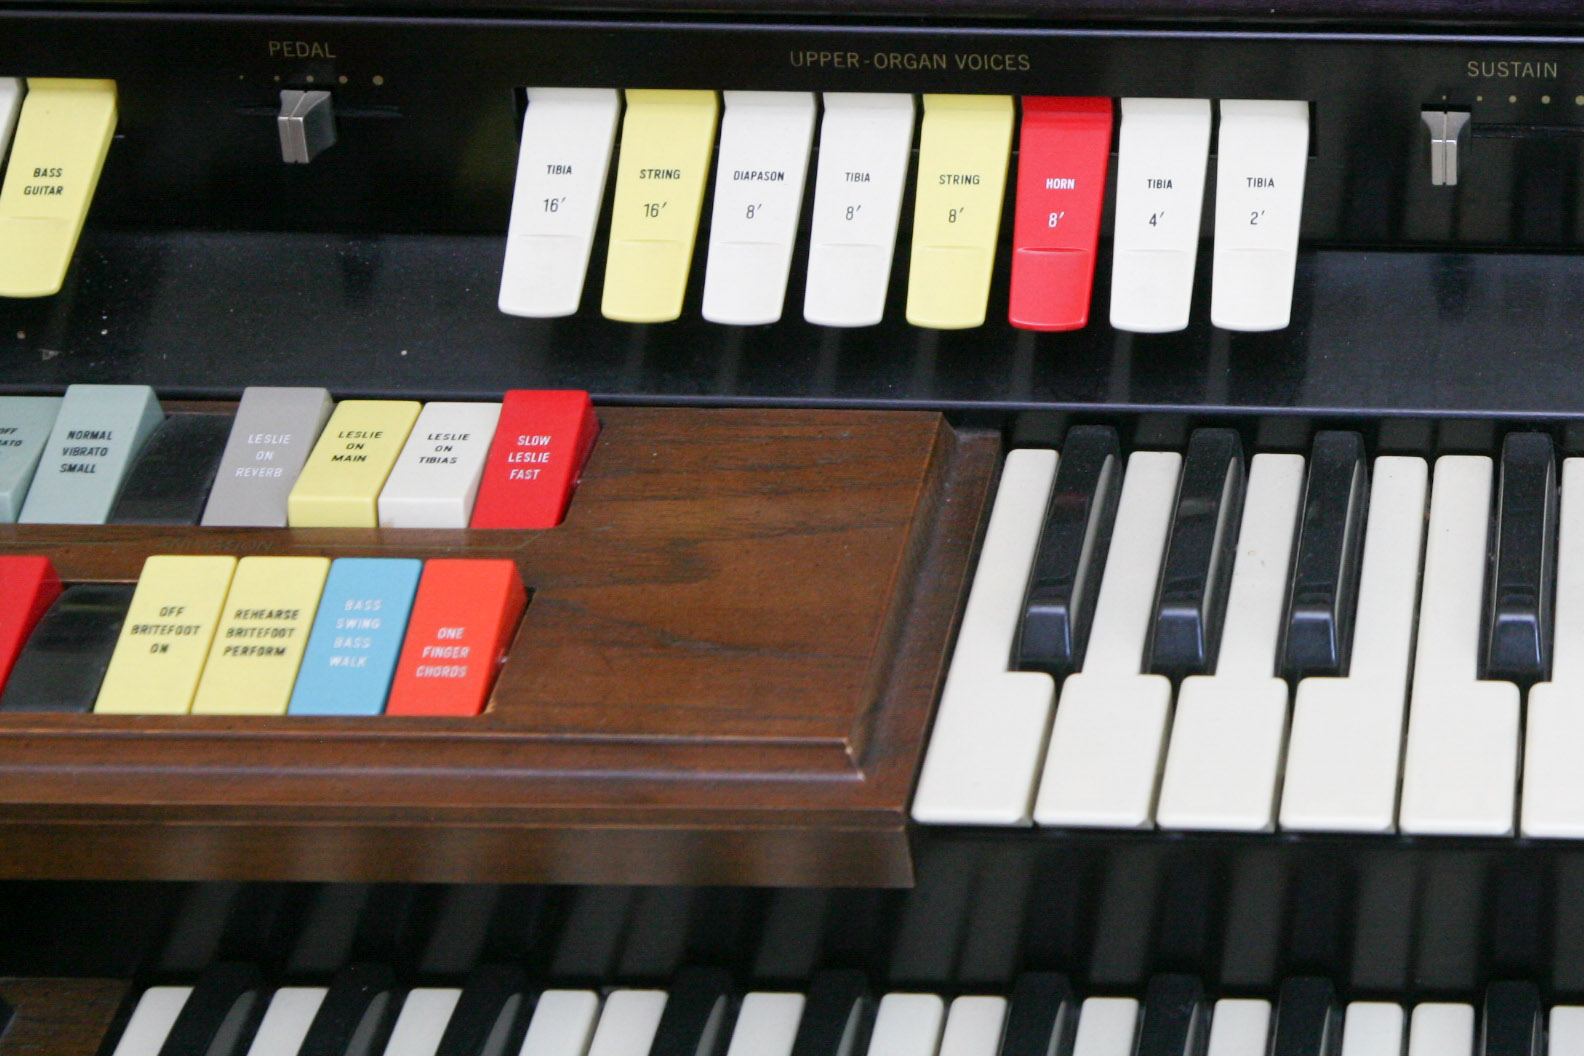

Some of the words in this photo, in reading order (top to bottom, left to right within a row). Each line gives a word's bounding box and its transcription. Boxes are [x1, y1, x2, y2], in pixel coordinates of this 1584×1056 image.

[268, 41, 337, 60] PEDAL
[955, 53, 1031, 71] VOICES
[1467, 60, 1558, 79] SUSTAIN
[33, 167, 63, 178] BASS
[546, 164, 573, 175] TIBIA
[639, 168, 681, 180] STRING
[733, 169, 785, 182] DIAPASON
[845, 172, 871, 183] TIBIA
[938, 173, 980, 186] STRING
[1246, 176, 1275, 188] TIBIA
[1045, 178, 1075, 190] HORN
[1147, 178, 1173, 190] TIBIA
[24, 185, 64, 196] GUITAR
[67, 430, 113, 441] NORMAL
[248, 434, 291, 444] LESLIE
[338, 430, 384, 440] LESLIE
[427, 432, 470, 441] LESLIE
[517, 435, 552, 447] SLOW
[62, 446, 108, 457] VIBRATO
[346, 442, 364, 451] ON
[434, 444, 453, 453] ON
[255, 450, 274, 461] ON
[331, 454, 368, 463] MAIN
[418, 456, 458, 465] TIBIAS
[508, 452, 550, 464] LESLIE
[59, 463, 97, 474] SMALL
[235, 467, 283, 478] REVERB
[509, 468, 541, 480] FAST
[344, 599, 383, 611] BASS
[159, 606, 187, 617] OFF
[234, 608, 300, 620] REHEARSE
[335, 617, 382, 630] SWING
[130, 624, 202, 636] BRITEFOOT
[225, 627, 296, 639] BRITEFOOT
[436, 627, 467, 640] ONE
[150, 643, 170, 654] ON
[333, 636, 372, 649] BASS
[222, 645, 287, 657] PERFORM
[421, 646, 470, 659] FINGER
[328, 655, 368, 668] WALK
[415, 665, 469, 678] CHORDS
